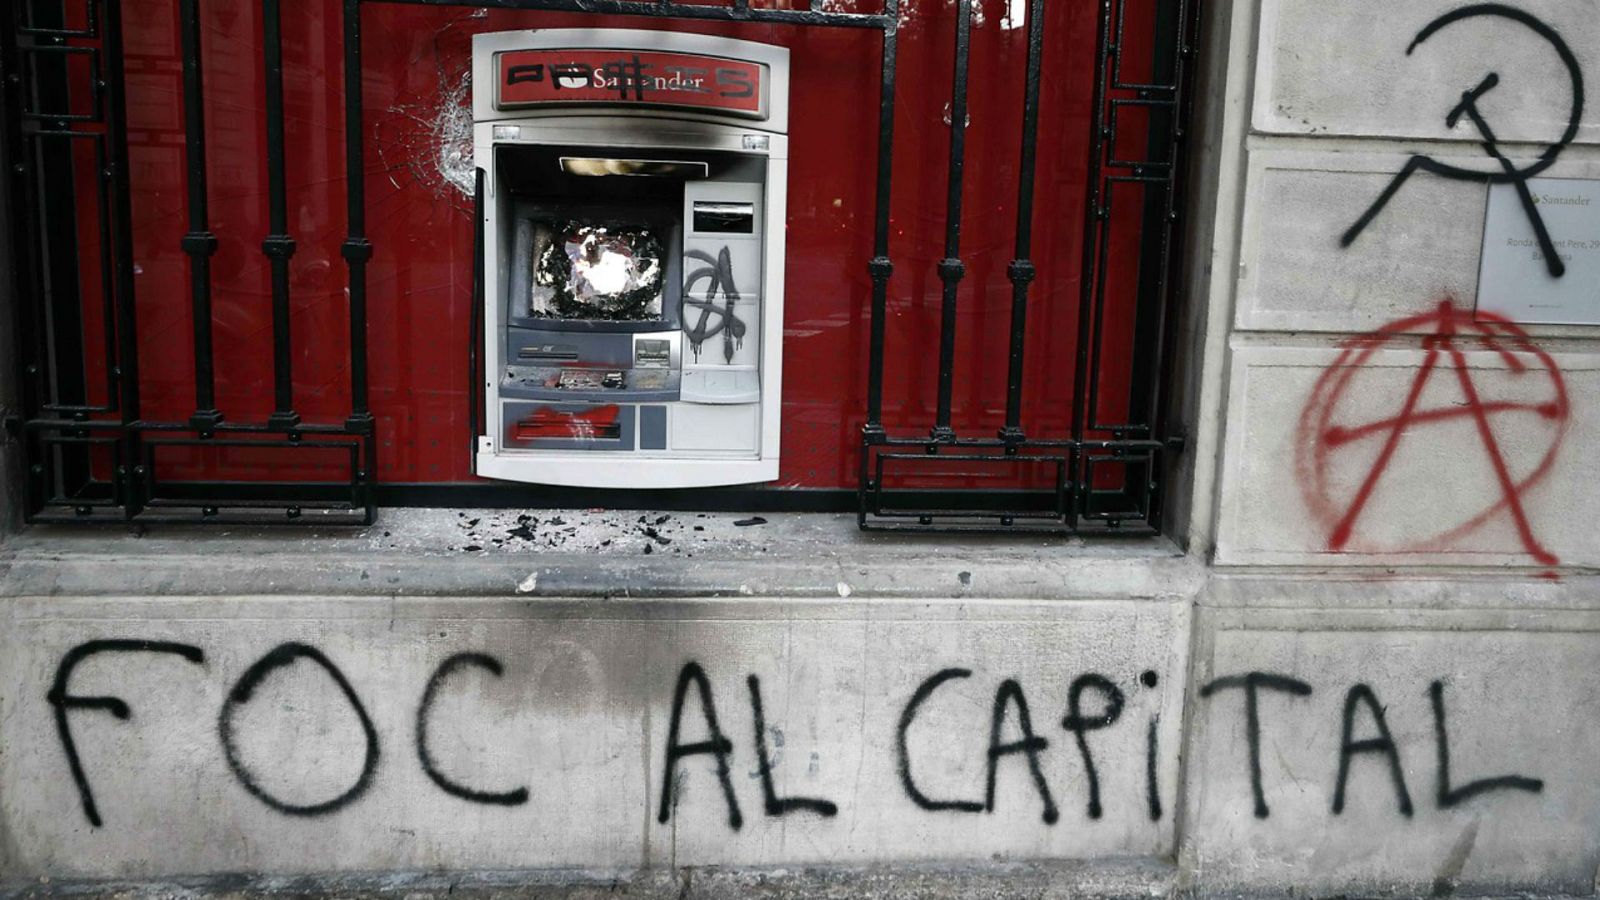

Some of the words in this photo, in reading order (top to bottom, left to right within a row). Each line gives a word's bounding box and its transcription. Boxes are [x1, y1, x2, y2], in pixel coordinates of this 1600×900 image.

[1541, 194, 1592, 206] Santander
[1506, 238, 1532, 248] Ronda
[47, 637, 530, 827] FOC
[657, 660, 838, 830] AL
